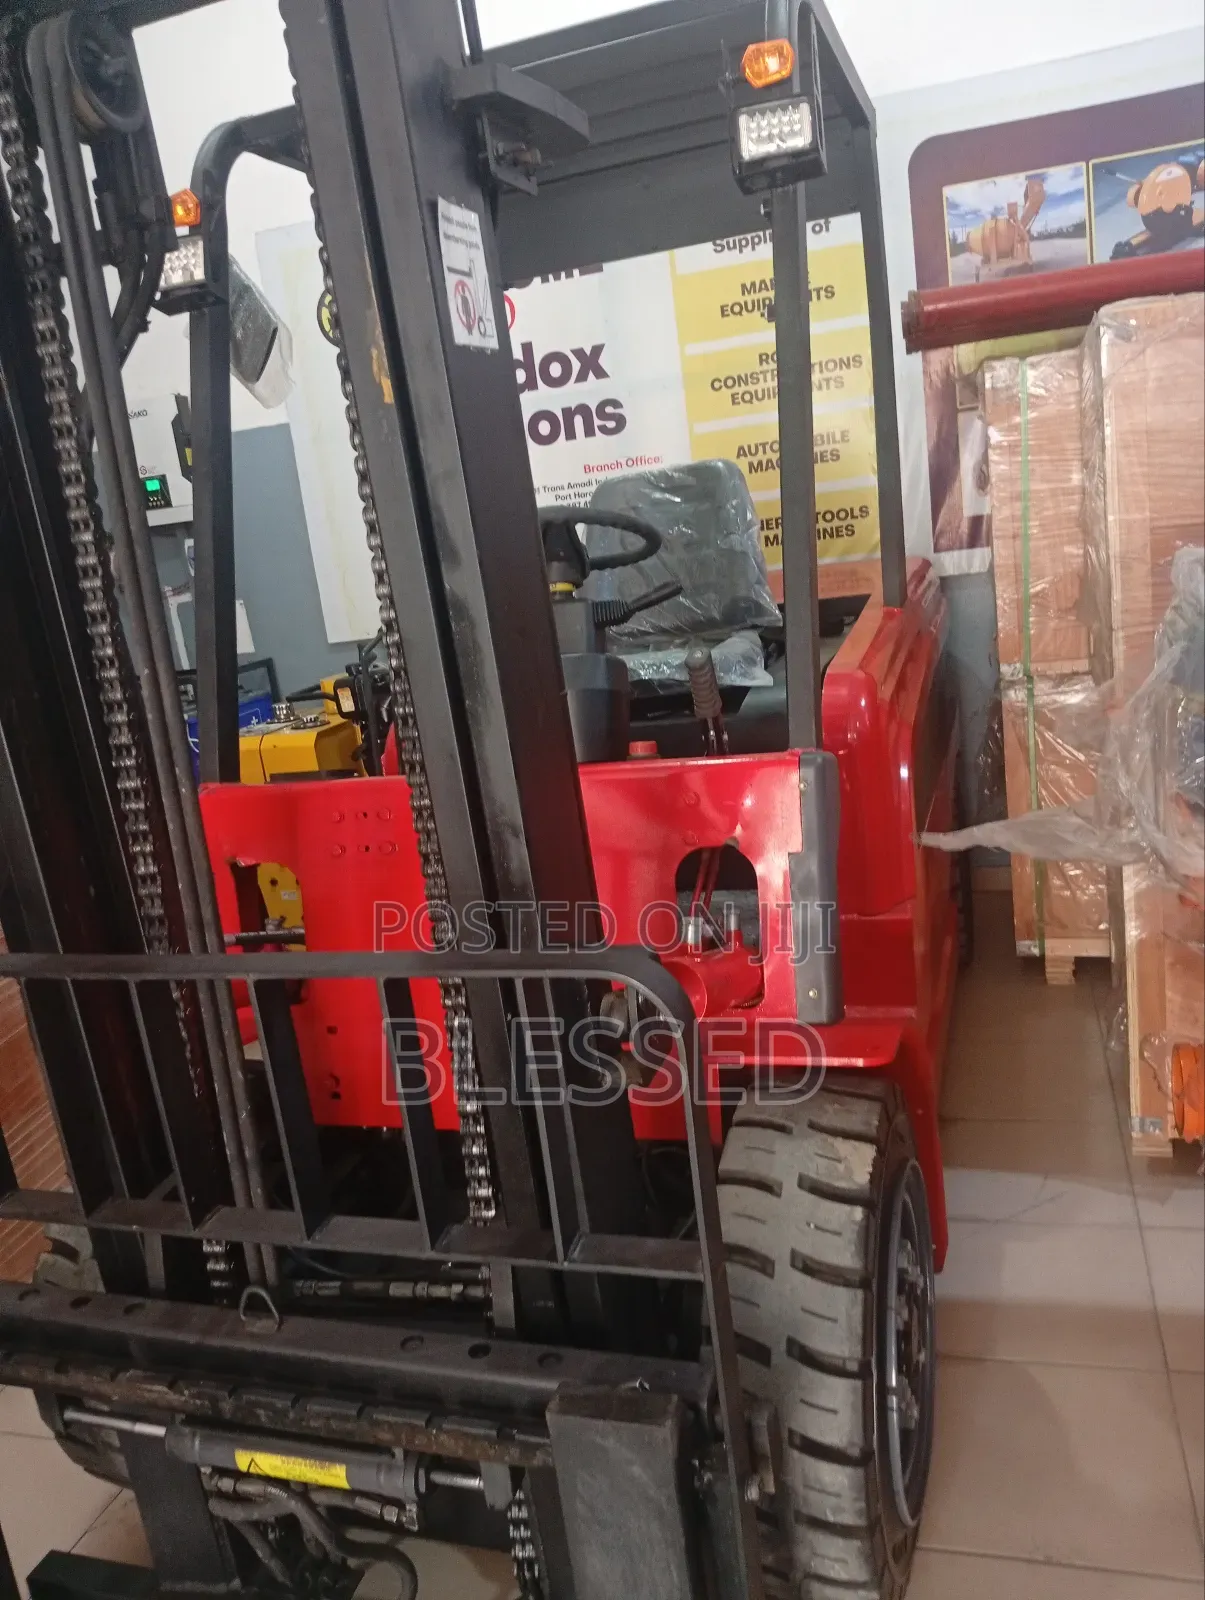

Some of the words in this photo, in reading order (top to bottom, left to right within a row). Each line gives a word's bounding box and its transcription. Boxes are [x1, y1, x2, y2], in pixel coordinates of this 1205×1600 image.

[811, 218, 831, 235] of
[720, 285, 836, 318] EQUIPTS
[710, 354, 863, 392] CONSTTIONS
[731, 376, 844, 406] EQUINTS
[527, 398, 627, 446] ons
[736, 429, 850, 459] AUTOBILE
[583, 461, 623, 474] Branch
[542, 484, 565, 493] Trans
[567, 479, 593, 490] Amadi
[554, 492, 572, 502] Port
